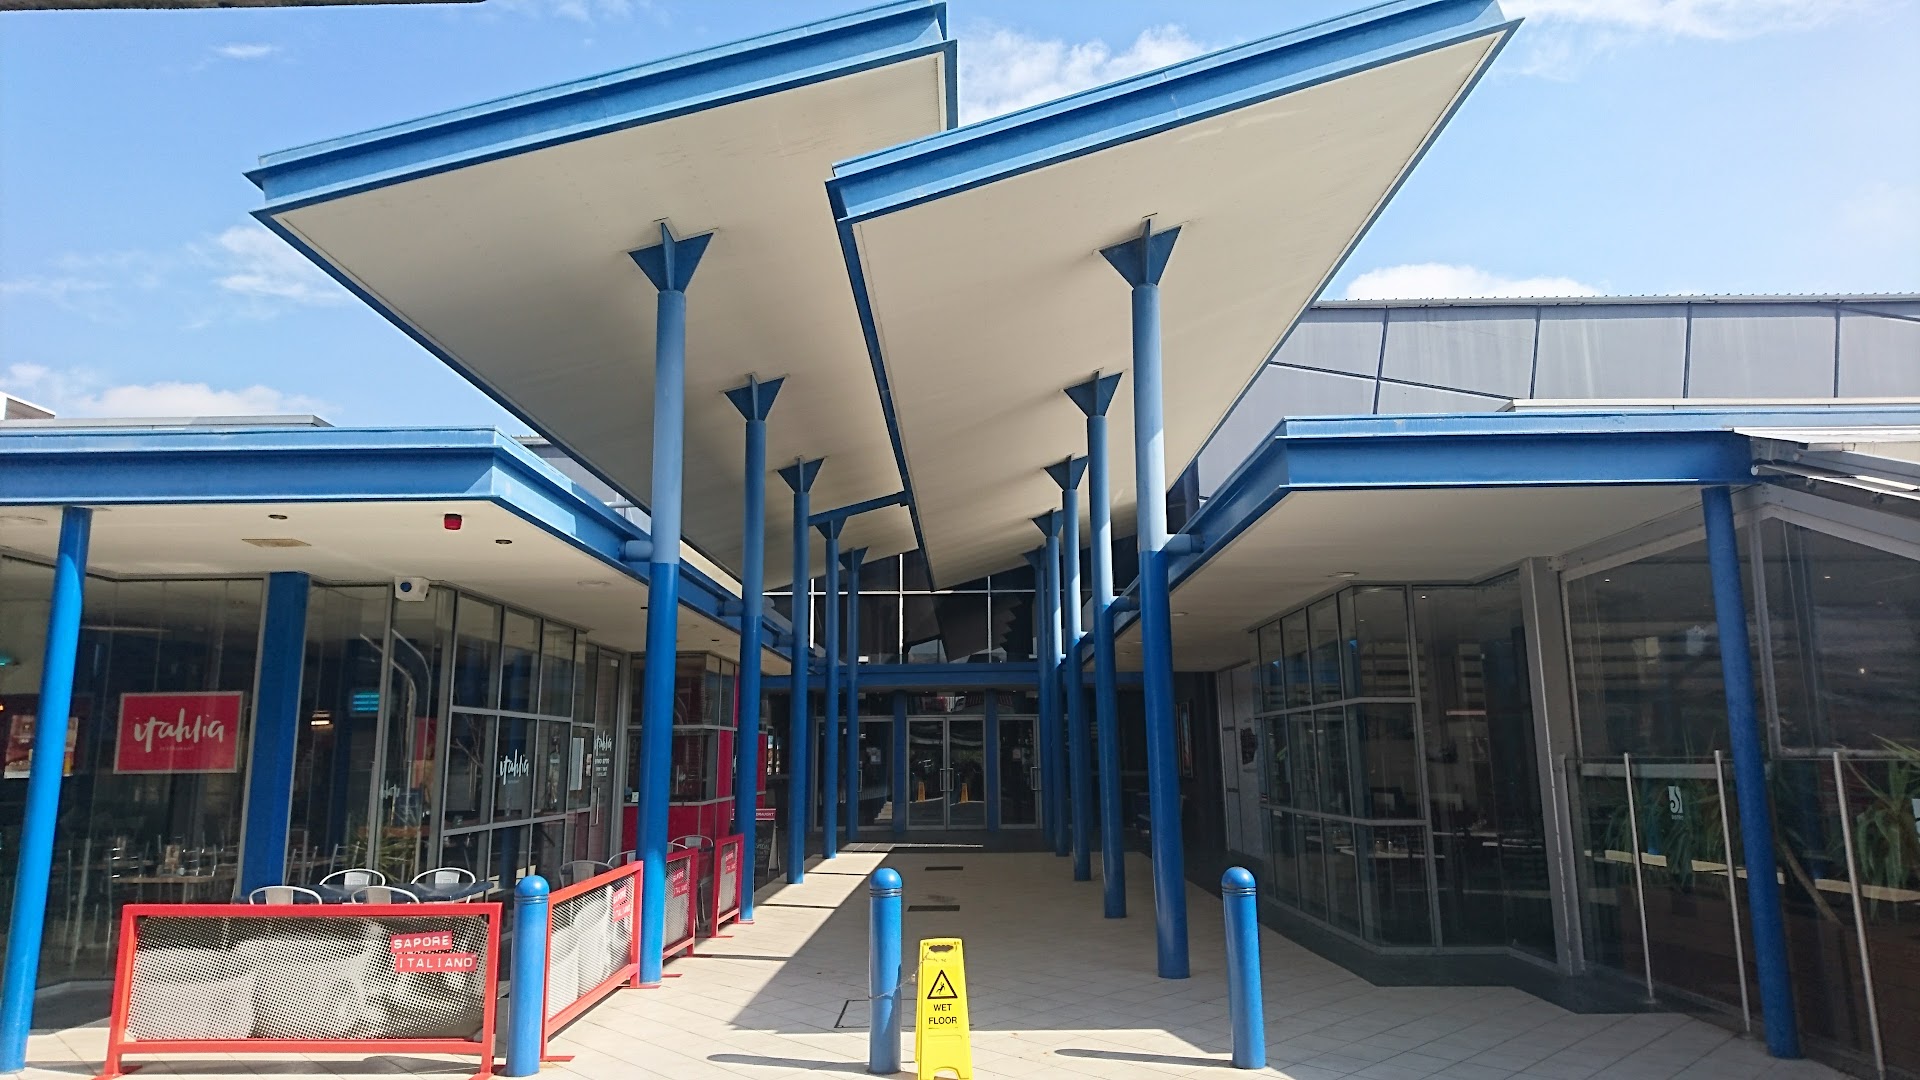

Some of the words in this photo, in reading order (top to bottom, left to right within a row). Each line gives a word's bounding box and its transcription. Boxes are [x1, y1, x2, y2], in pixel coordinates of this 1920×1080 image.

[134, 708, 224, 753] itahlia
[393, 935, 450, 949] SAPORE
[399, 957, 473, 968] ITALIANO
[933, 1003, 952, 1011] WET
[928, 1016, 958, 1024] FLOOR
